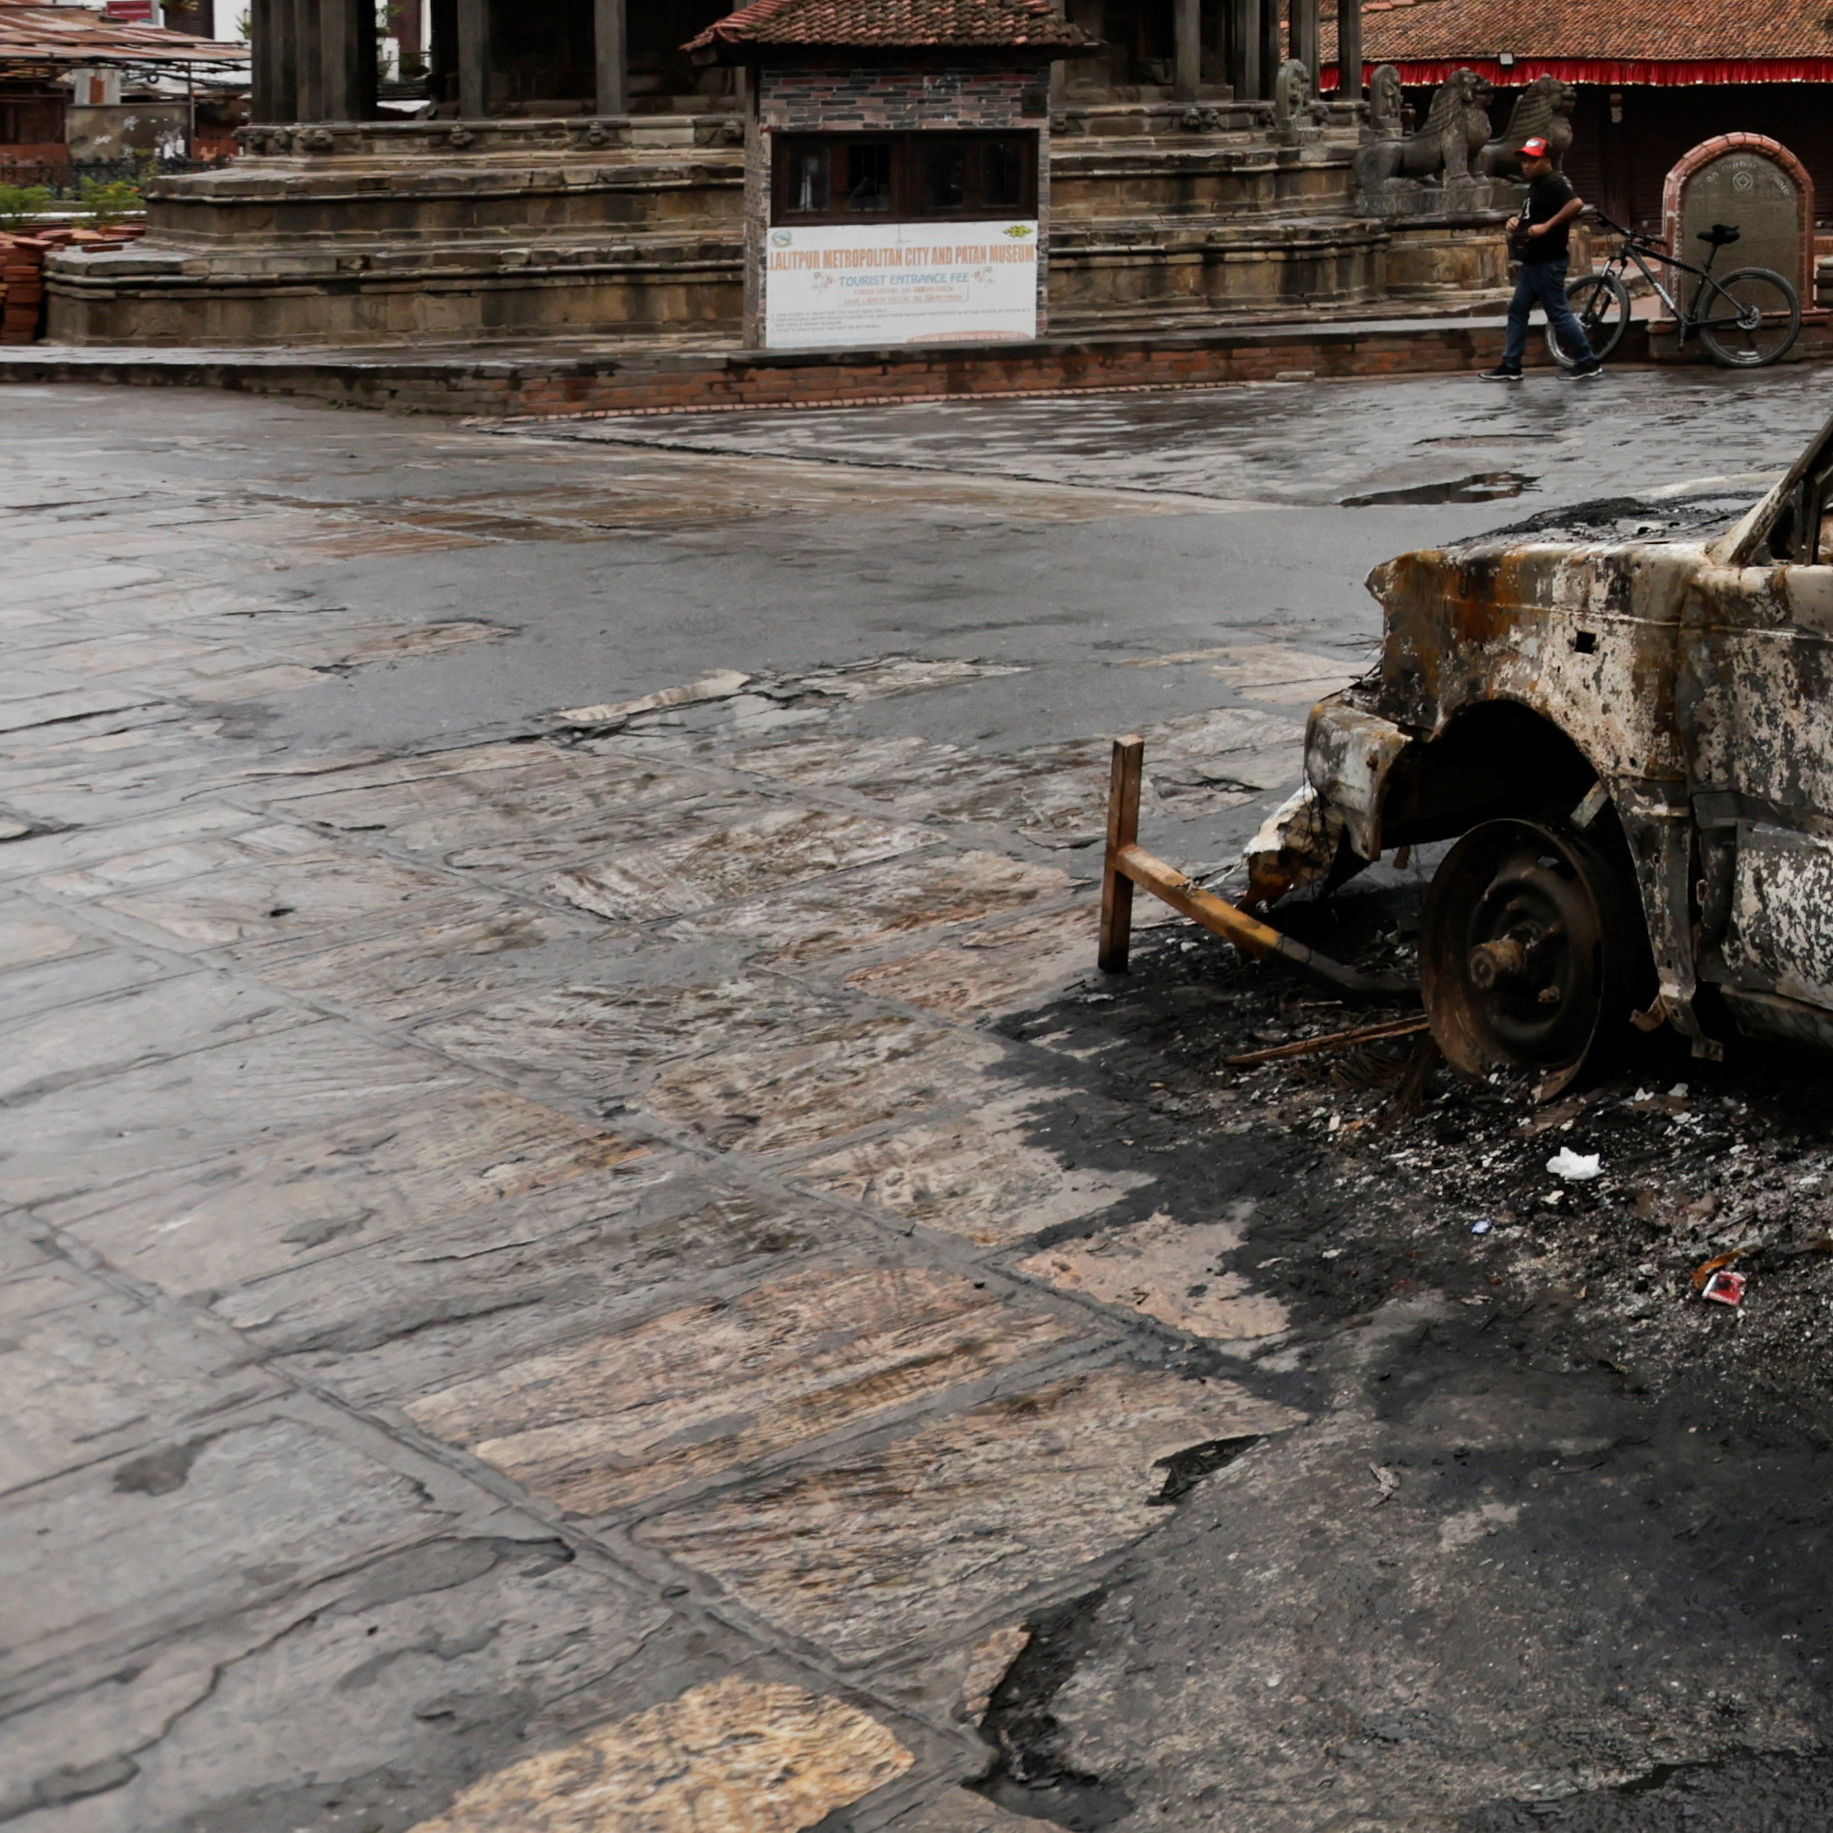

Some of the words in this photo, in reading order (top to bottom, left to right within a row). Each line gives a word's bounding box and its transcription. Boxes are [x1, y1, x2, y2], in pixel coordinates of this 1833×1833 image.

[770, 250, 820, 270] LALITPUR
[823, 248, 902, 268] METROPOLITAN
[905, 246, 929, 266] CITY
[931, 245, 953, 265] AND
[955, 245, 987, 264] PATAN
[989, 244, 1034, 263] MUSEUM
[839, 275, 886, 287] TOURIST
[890, 273, 948, 285] ENTRANCE
[950, 272, 969, 283] FEE
